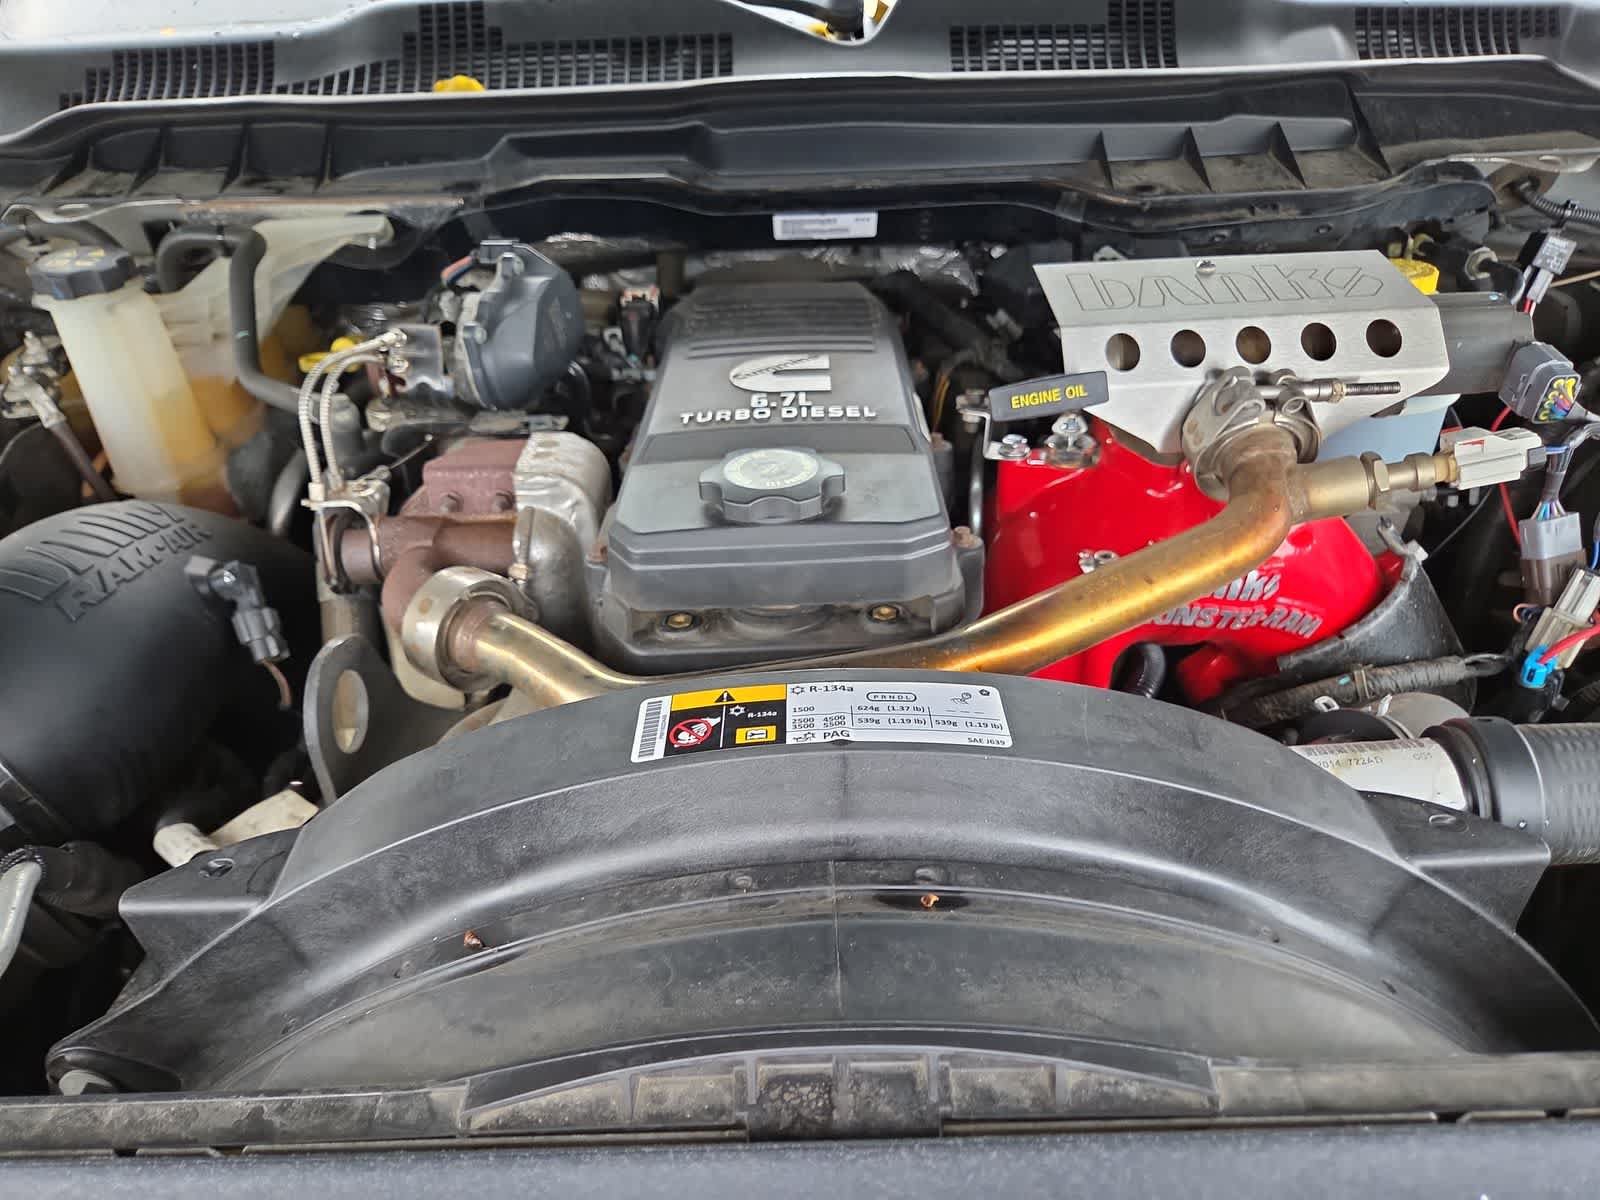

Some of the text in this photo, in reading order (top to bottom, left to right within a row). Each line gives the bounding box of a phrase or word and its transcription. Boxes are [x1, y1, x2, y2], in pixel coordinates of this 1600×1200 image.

[750, 392, 813, 408] 6.7L
[1010, 383, 1089, 409] ENGINE OIL
[679, 404, 877, 425] TURBO DIESEL
[1151, 604, 1325, 640] ONSTER-RAM
[809, 684, 854, 693] R-134a
[747, 710, 778, 719] R-134a
[792, 704, 926, 713] 1500 624g (1.37 lb)
[857, 717, 881, 725] 539g
[887, 717, 912, 725] (1.19
[914, 718, 927, 726] lb)
[935, 719, 959, 728] 539g
[965, 720, 989, 729] (1.19
[991, 722, 1004, 731] lb)
[823, 729, 851, 740] PAG
[967, 736, 985, 744] SAE
